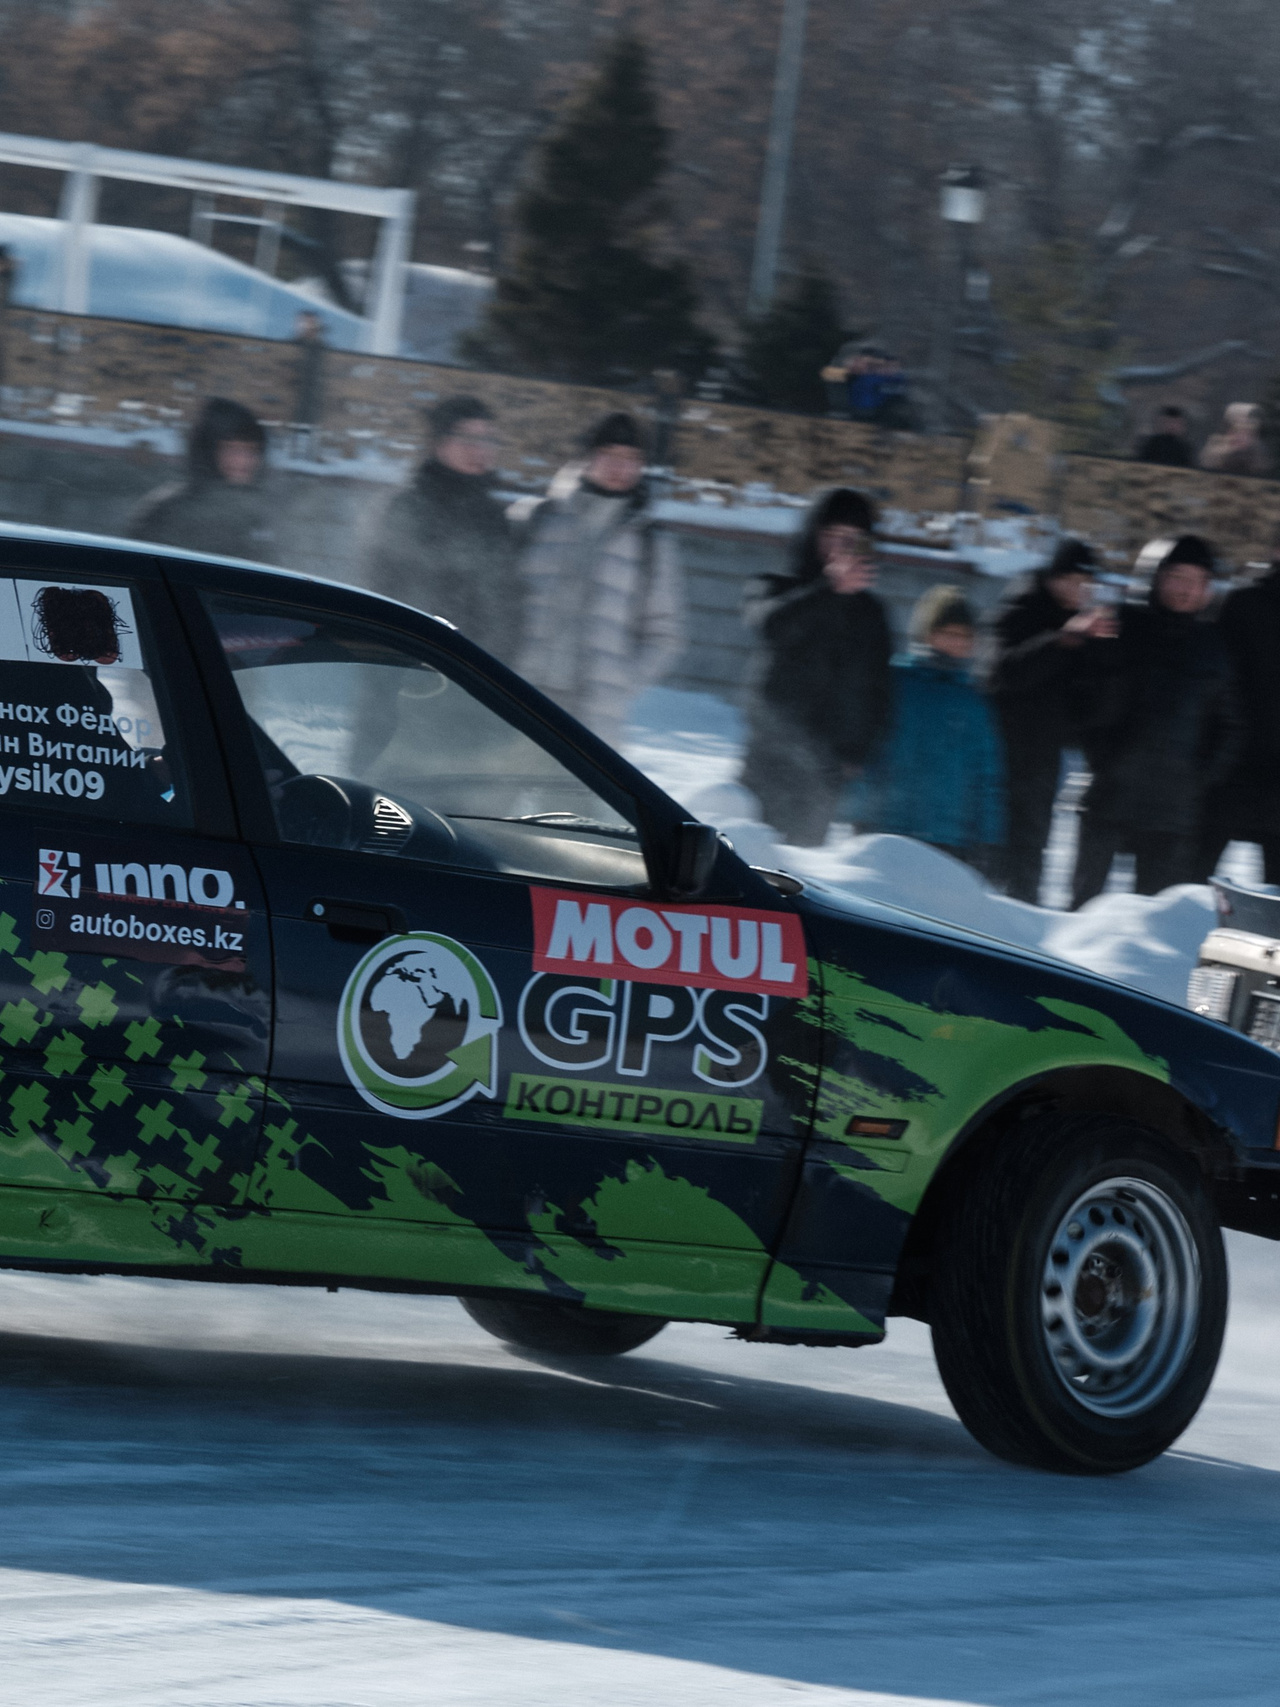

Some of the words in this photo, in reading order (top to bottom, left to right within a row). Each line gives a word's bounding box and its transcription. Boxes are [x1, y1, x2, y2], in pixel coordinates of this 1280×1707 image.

[56, 703, 152, 743] Фёдор
[28, 732, 146, 769] Виталий
[70, 912, 244, 951] autoboxes.kz
[545, 899, 797, 983] MOTUL
[518, 970, 769, 1088] GPS
[514, 1081, 754, 1138] КОНТРОЛЬ
